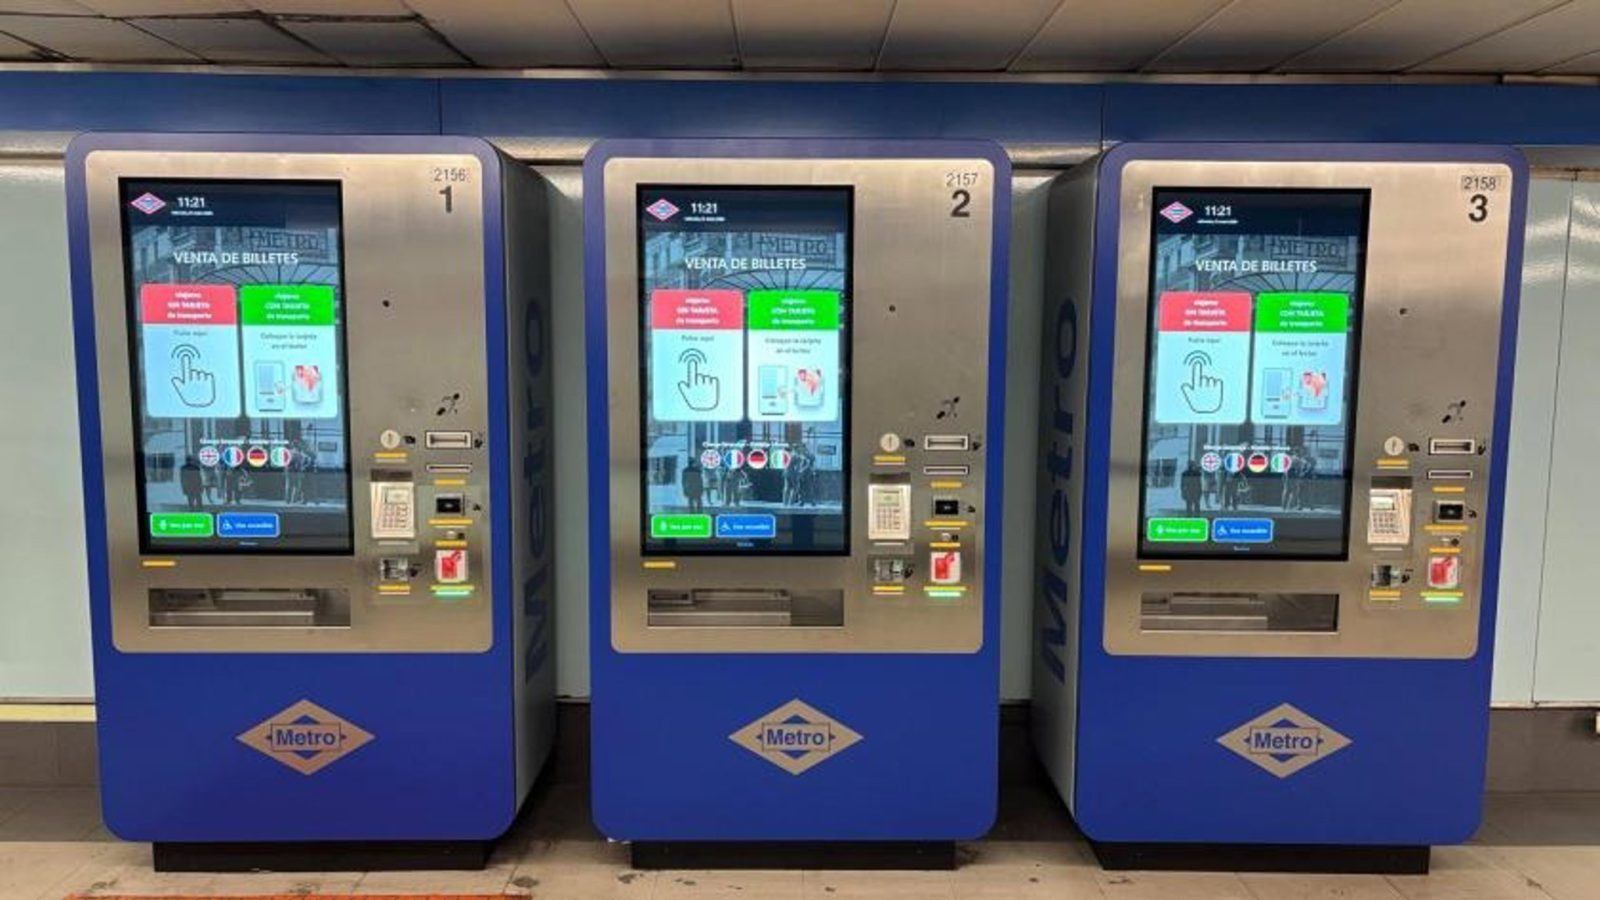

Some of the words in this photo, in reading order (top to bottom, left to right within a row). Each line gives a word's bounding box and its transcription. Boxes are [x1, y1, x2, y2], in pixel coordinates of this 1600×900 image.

[433, 167, 466, 182] 2156
[945, 172, 978, 187] 2157
[1463, 176, 1496, 191] 2158
[176, 196, 205, 208] 11:21
[439, 185, 452, 214] 1
[951, 189, 970, 217] 2
[691, 202, 718, 214] 11:21
[1204, 205, 1232, 217] 11:21
[1468, 194, 1488, 222] 3
[174, 251, 217, 264] VENTA
[221, 252, 239, 264] DE
[243, 252, 299, 265] BILLETES
[684, 257, 728, 269] VENTA
[731, 257, 747, 270] DE
[752, 257, 806, 270] BILLETES
[1195, 260, 1238, 272] VENTA
[1241, 260, 1257, 272] DE
[1262, 260, 1318, 273] BILLETES
[523, 299, 549, 686] Metro
[1040, 296, 1077, 686] Metro
[276, 729, 336, 746] Metro
[766, 728, 825, 746] Metro
[1254, 732, 1313, 749] Metro
